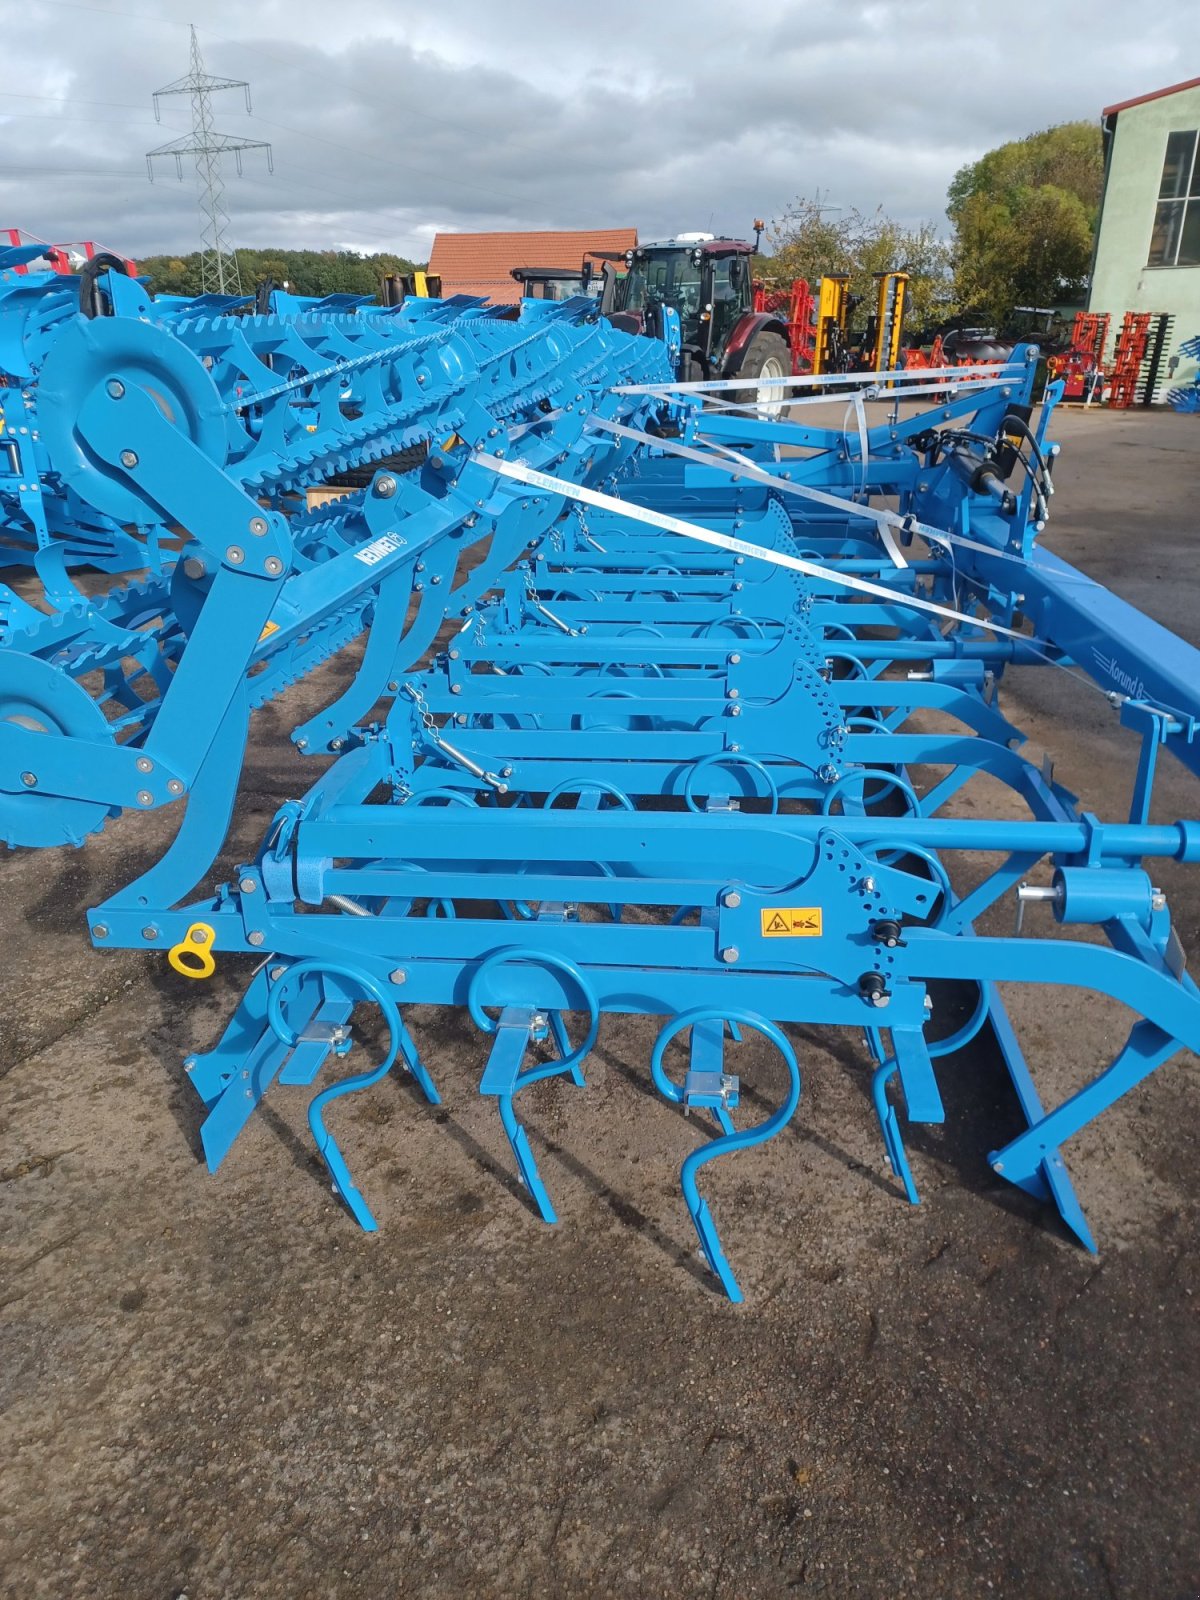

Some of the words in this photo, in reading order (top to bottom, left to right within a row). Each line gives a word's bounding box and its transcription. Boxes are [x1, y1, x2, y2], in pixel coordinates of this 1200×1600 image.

[536, 476, 581, 498] LEMKEN
[353, 535, 401, 566] LEMKEN
[1109, 657, 1139, 696] Korund
[1135, 681, 1144, 700] 8
